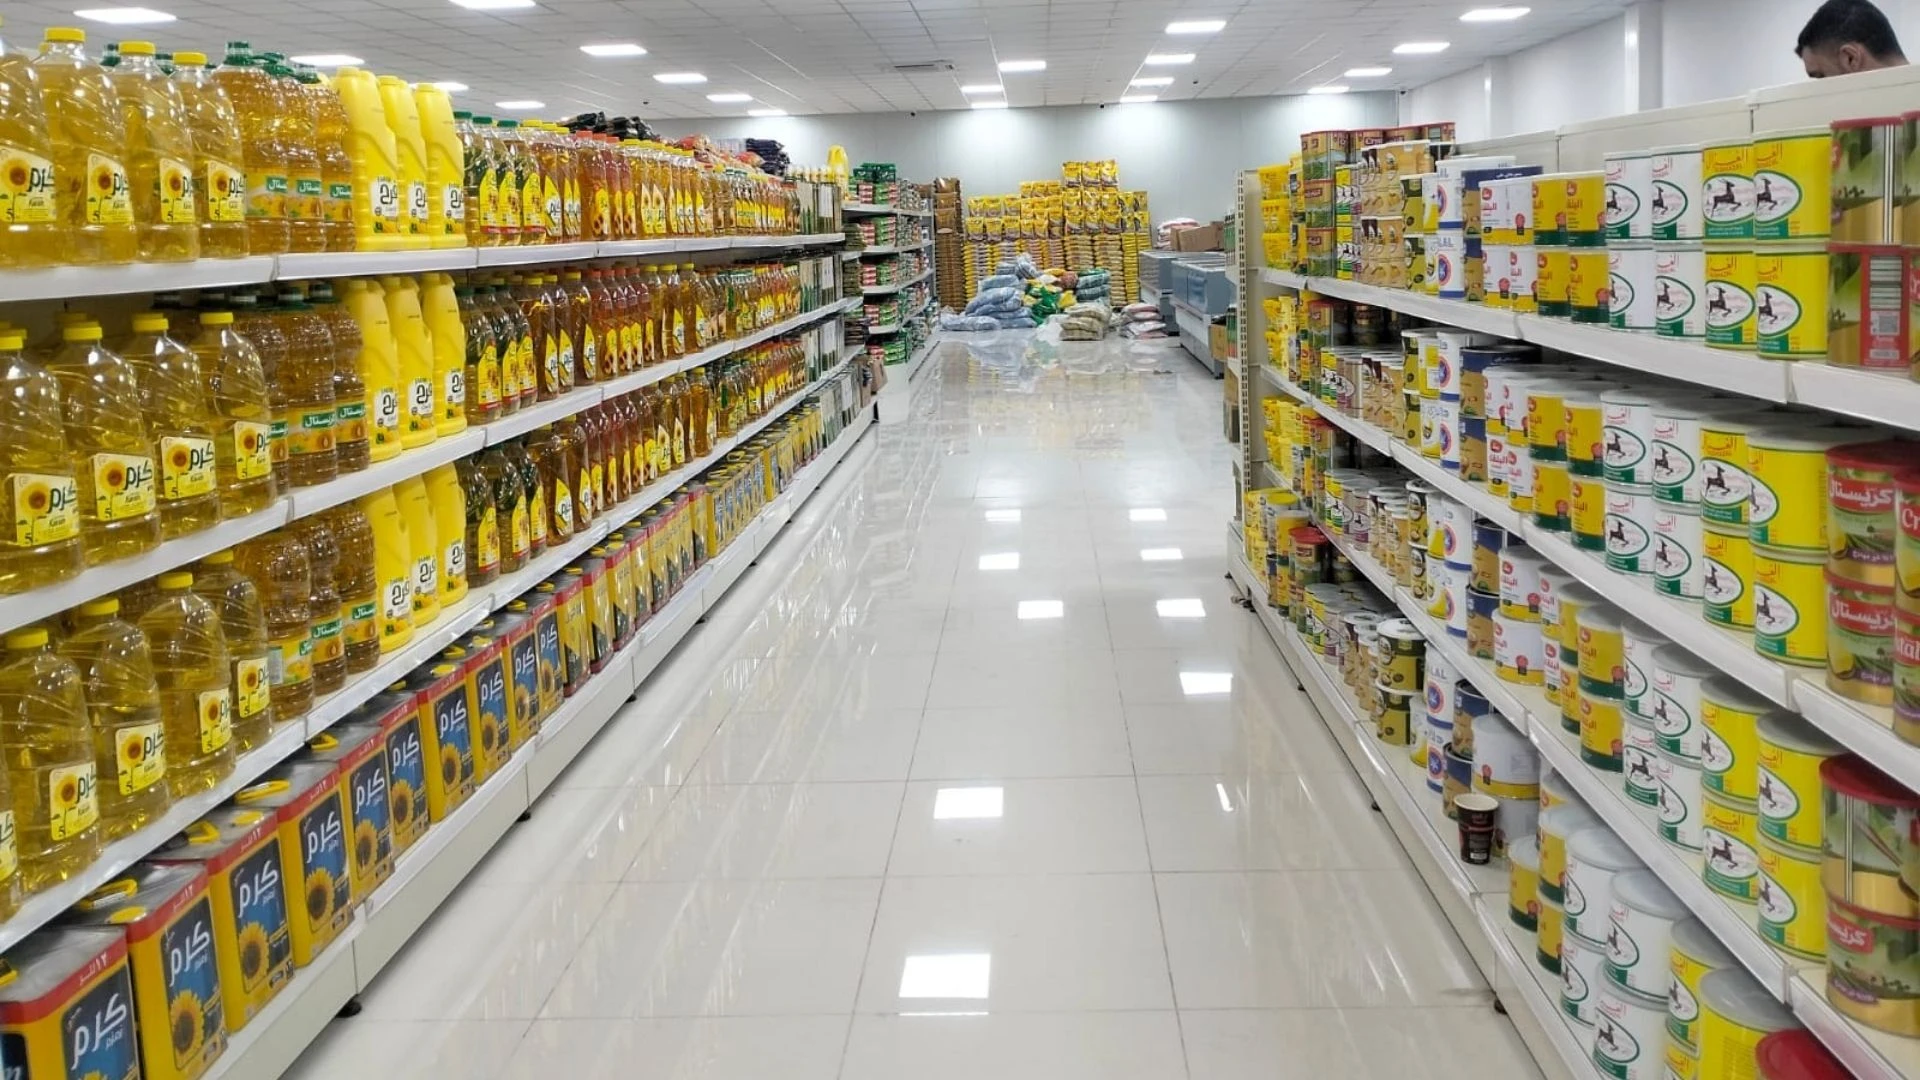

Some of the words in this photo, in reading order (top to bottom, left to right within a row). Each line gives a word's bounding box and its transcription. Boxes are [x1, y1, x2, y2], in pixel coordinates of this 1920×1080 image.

[123, 460, 153, 491] كرم
[188, 442, 214, 472] كرم
[48, 481, 76, 513] كرم
[1829, 477, 1894, 508] كريستال
[515, 645, 536, 679] كرم
[480, 669, 505, 708] كرم
[440, 698, 467, 738] كرم
[391, 731, 421, 775] كرم
[355, 767, 386, 815] كرم
[306, 811, 342, 864] كرم
[238, 860, 279, 919] كرم
[169, 920, 210, 987] كرم
[71, 993, 128, 1071] كرم
